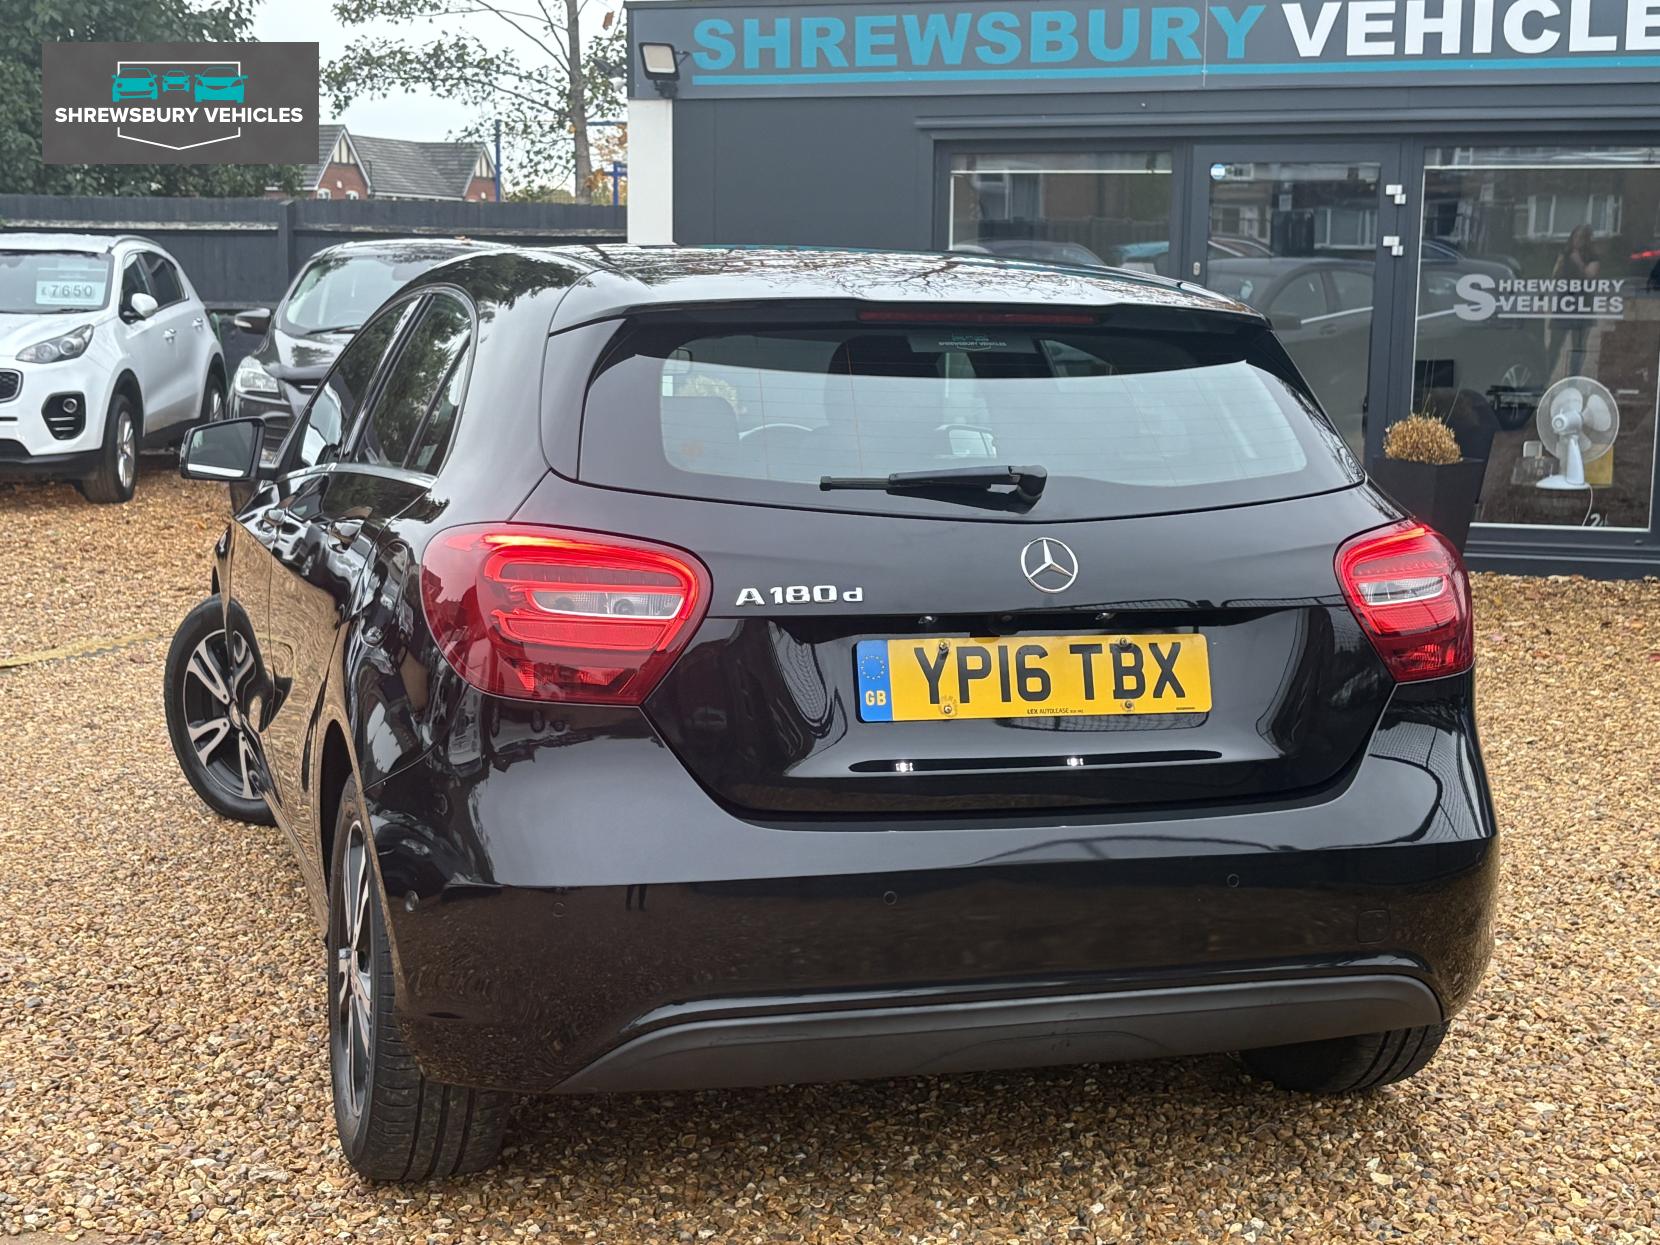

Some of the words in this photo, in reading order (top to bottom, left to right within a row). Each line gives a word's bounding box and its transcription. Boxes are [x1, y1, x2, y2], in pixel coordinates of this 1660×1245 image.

[692, 5, 1267, 70] SHREWSBURY
[1281, 0, 1660, 57] VEHICLE
[1453, 273, 1625, 322] SHREWSBURY
[1498, 295, 1624, 313] VEHICLES
[913, 643, 1052, 705] YP16
[1069, 641, 1186, 701] TBX
[865, 689, 887, 707] GB
